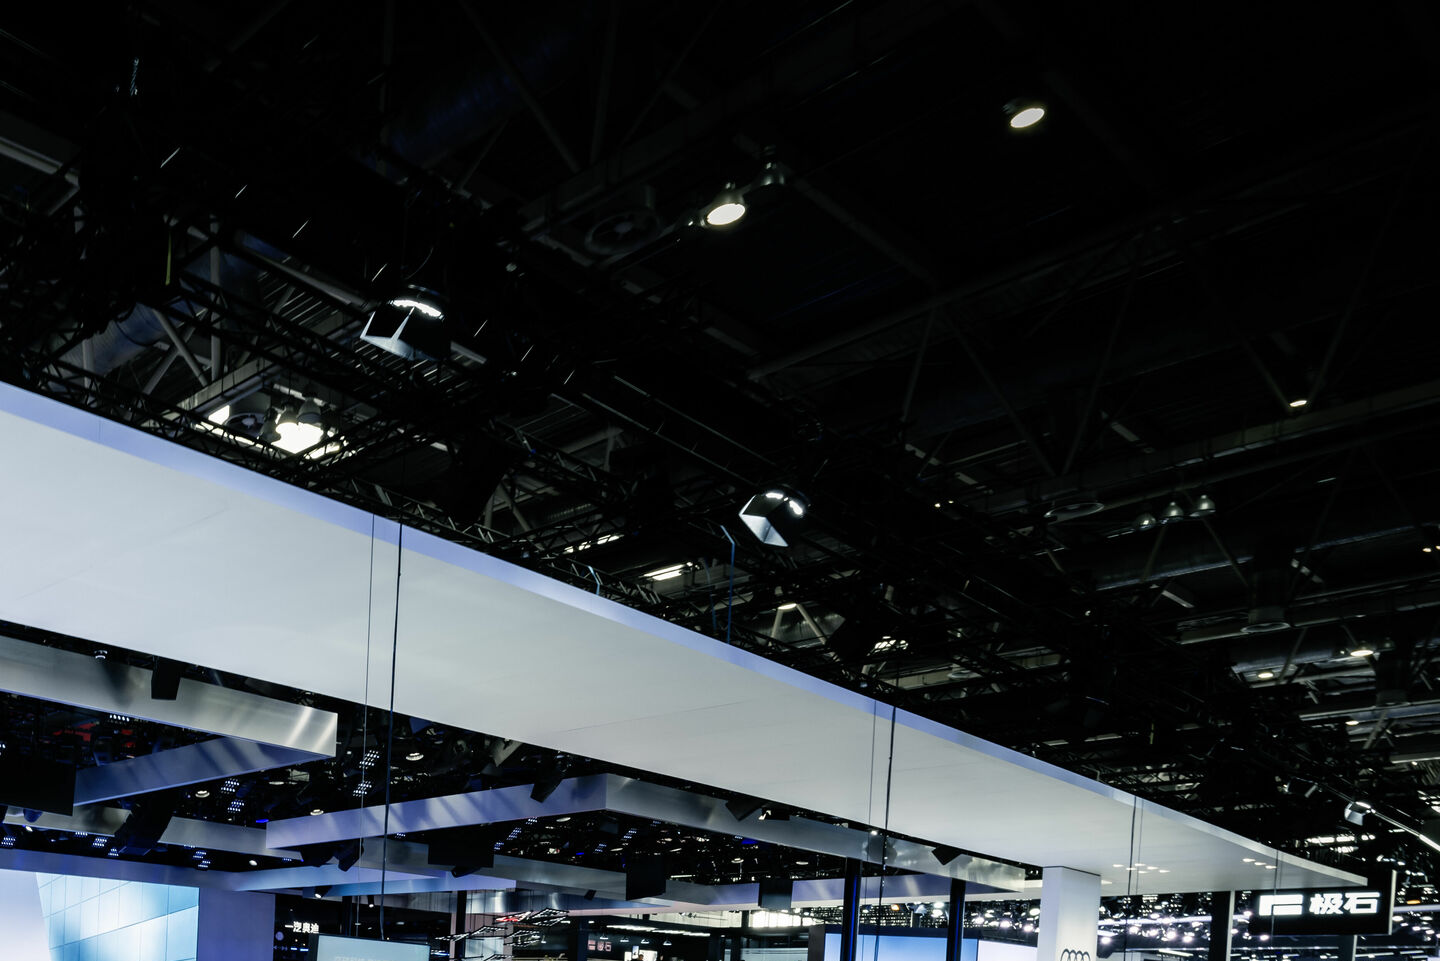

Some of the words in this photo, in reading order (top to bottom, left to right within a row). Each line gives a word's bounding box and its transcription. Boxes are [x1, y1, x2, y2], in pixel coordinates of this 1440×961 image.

[1308, 892, 1380, 915] 极石
[284, 920, 320, 934] 一汽奥迪
